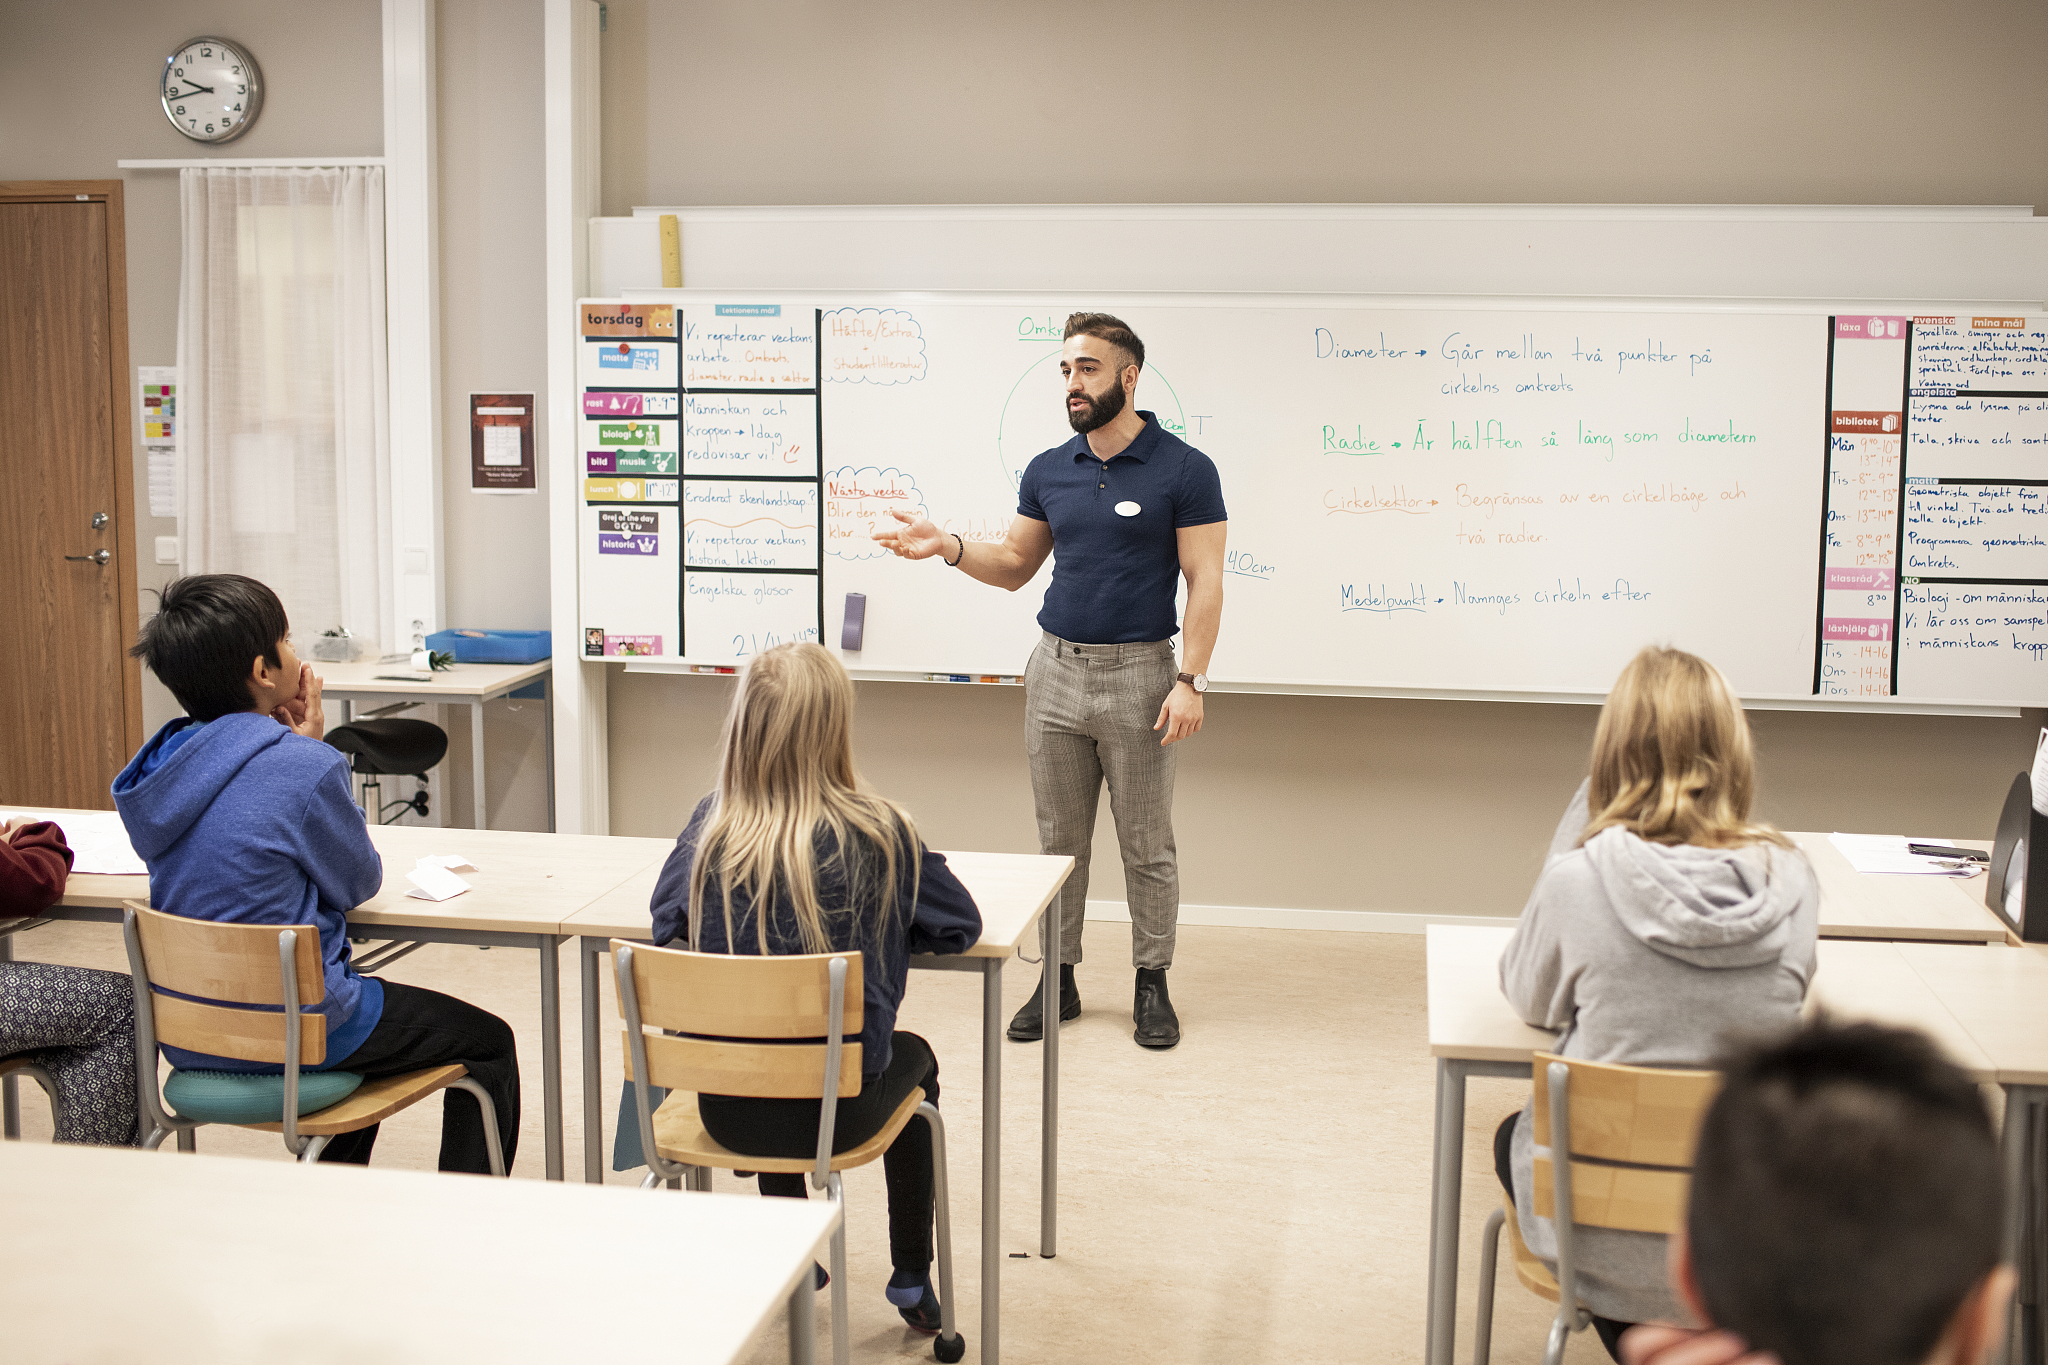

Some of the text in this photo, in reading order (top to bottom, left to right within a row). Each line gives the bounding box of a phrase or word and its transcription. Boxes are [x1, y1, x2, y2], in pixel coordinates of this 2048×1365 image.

[186, 55, 193, 64] 11
[200, 48, 212, 57] 12
[221, 52, 225, 61] 1
[174, 68, 184, 77] 10
[231, 65, 240, 74] 2
[169, 87, 179, 96] 9
[237, 84, 246, 94] 3
[176, 105, 186, 115] 8
[233, 103, 241, 111] 4
[189, 119, 197, 129] 7
[205, 123, 214, 133] 6
[222, 117, 231, 127] 5
[760, 306, 775, 314] mål
[587, 312, 643, 328] torsdag
[1974, 318, 2023, 327] mina mål
[1839, 323, 1861, 332] läxa
[2006, 330, 2025, 338] och
[686, 321, 813, 351] Vi repeterar veckans
[602, 354, 629, 362] matte
[1315, 327, 1712, 377] Diameter Går mellan två punkter på
[833, 355, 922, 370] Studentlitteratur
[1441, 372, 1574, 395] cirkelns omkrets
[1911, 388, 1957, 397] engelska
[685, 397, 787, 416] Människan och
[1955, 400, 1972, 411] och
[2018, 404, 2030, 415] på
[1191, 415, 1213, 435] T
[1836, 416, 1879, 426] bibliotek
[602, 430, 632, 441] biologi
[685, 419, 731, 444] kroppen
[1948, 432, 1980, 445] skriva
[1991, 431, 2012, 444] och
[1323, 416, 1756, 462] Radie Är hälften så lång som diametern
[1831, 436, 1855, 451] Mån
[687, 441, 751, 460] redovisar
[591, 458, 608, 466] bild
[620, 458, 647, 466] musik
[1830, 470, 1849, 486] Tis
[1909, 477, 1939, 485] matte
[685, 486, 732, 503] Eroderat
[829, 479, 908, 497] Nästa vecka
[1908, 485, 2038, 501] Geometriska objekt från
[1323, 480, 1747, 520] Cirkelsektor Begränsas av en cirkelbåge och
[1908, 500, 1921, 511] till
[1996, 502, 2014, 514] och
[827, 501, 877, 518] Blir den
[1827, 510, 1846, 521] Ons
[626, 514, 639, 522] the
[640, 515, 655, 524] day
[1908, 513, 1934, 523] nella
[1456, 521, 1549, 545] två radier.
[1827, 532, 1842, 547] Fre
[602, 540, 636, 549] historia
[686, 528, 807, 553] Vi repeterar veckans
[1908, 531, 2047, 552] Programmera geometriska
[688, 548, 776, 566] historia lektion
[1227, 550, 1275, 574] 40cm
[1830, 574, 1873, 583] klassråd
[688, 576, 794, 605] Engelska glosor
[1341, 577, 1651, 620] Medelpunkt Namnges cirkeln efter
[1903, 587, 1949, 613] Biologi
[1905, 610, 1997, 629] Vi lär oss om
[1828, 624, 1868, 635] läxhjälp
[1919, 632, 1999, 649] människans
[1823, 643, 1842, 658] Tis
[1823, 664, 1847, 677] Ons
[1821, 681, 1848, 696] Tors
